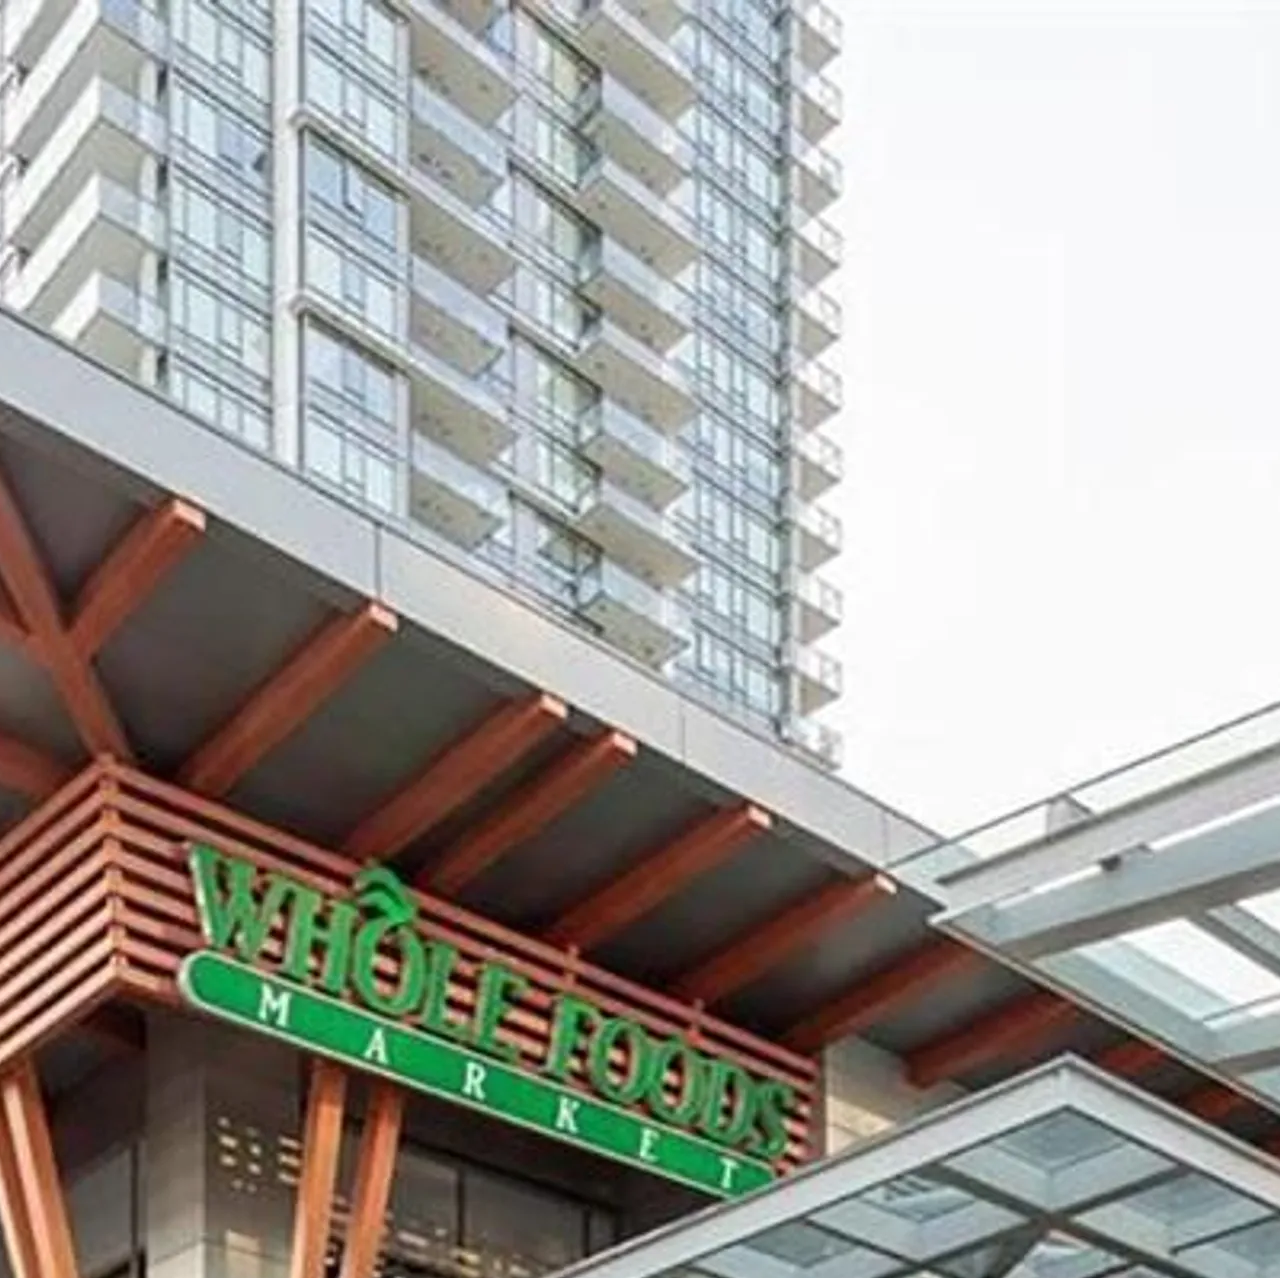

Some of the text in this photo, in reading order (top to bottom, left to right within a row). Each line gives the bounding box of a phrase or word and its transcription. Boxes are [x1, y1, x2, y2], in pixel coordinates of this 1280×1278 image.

[187, 842, 794, 1159] WHOLE FOODS
[257, 984, 740, 1189] MARKET
